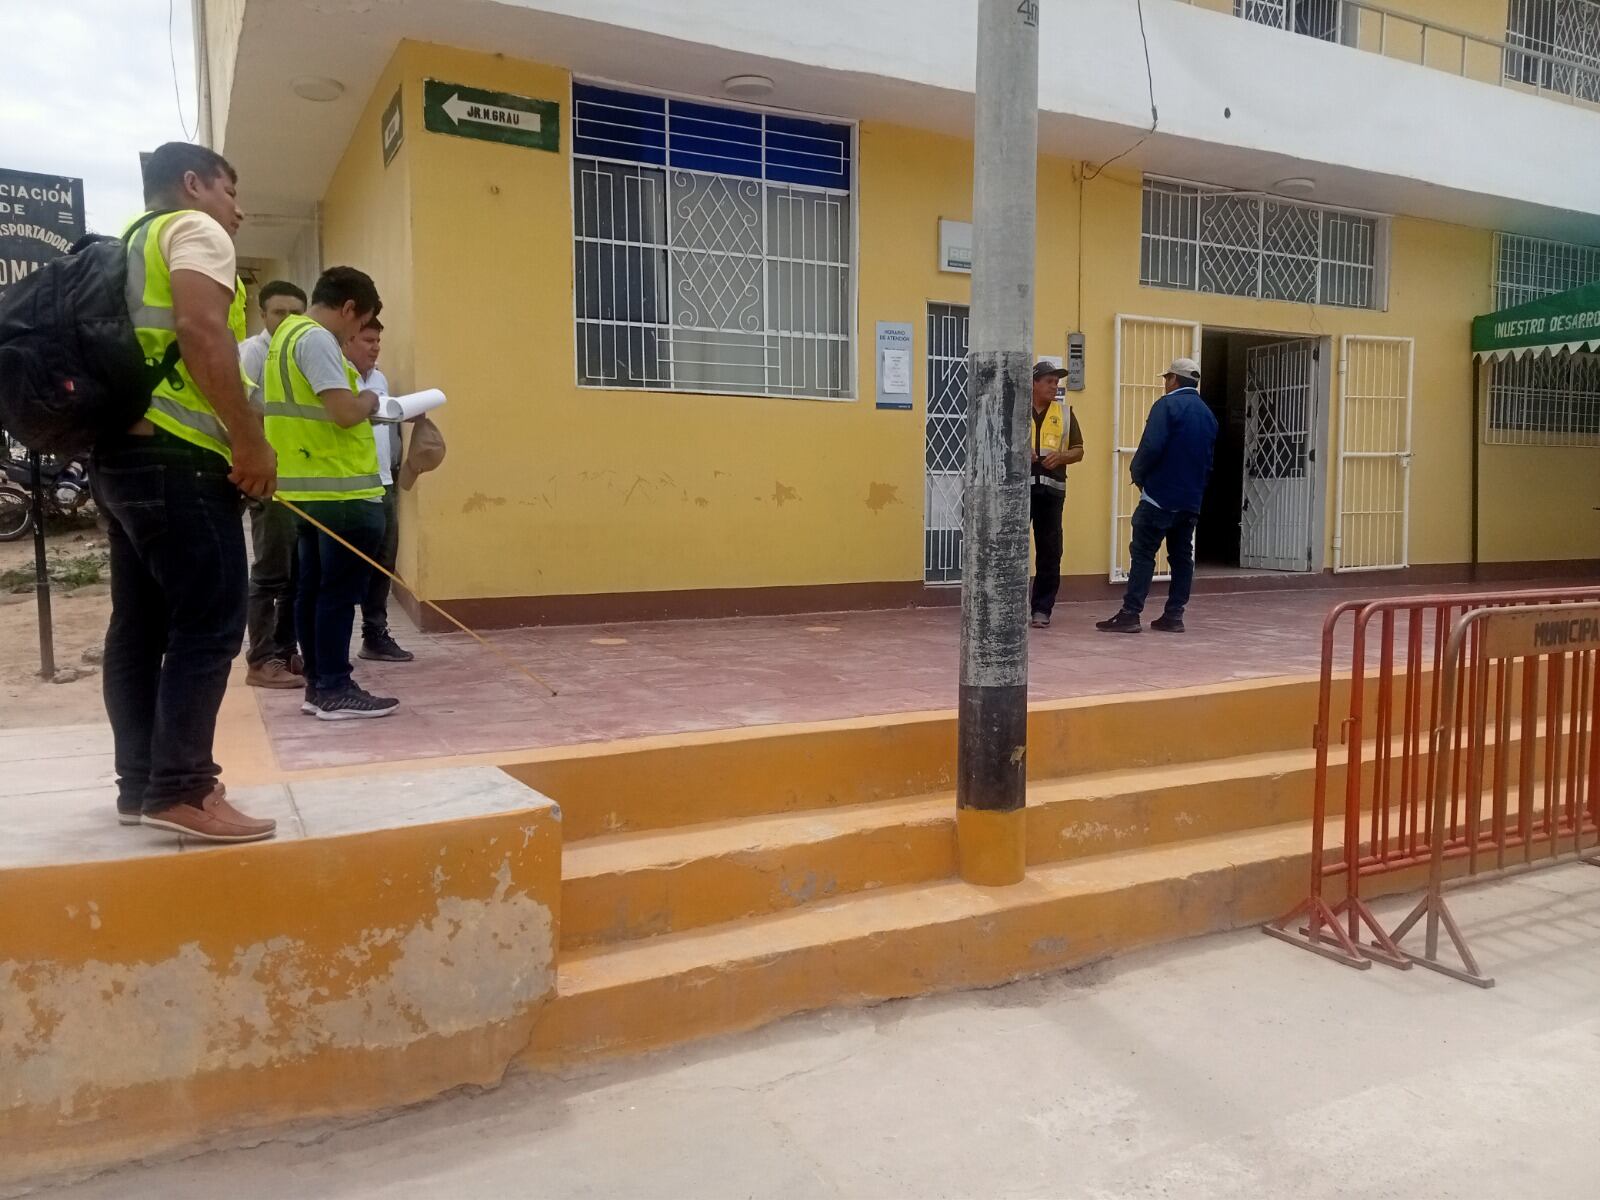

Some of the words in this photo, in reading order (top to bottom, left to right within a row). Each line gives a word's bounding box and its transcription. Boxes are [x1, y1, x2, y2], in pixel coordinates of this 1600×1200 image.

[0, 202, 26, 216] DE
[0, 222, 75, 255] SPORTADORE
[1549, 310, 1600, 332] DESARRO
[1534, 617, 1600, 648] MUNICIPA
